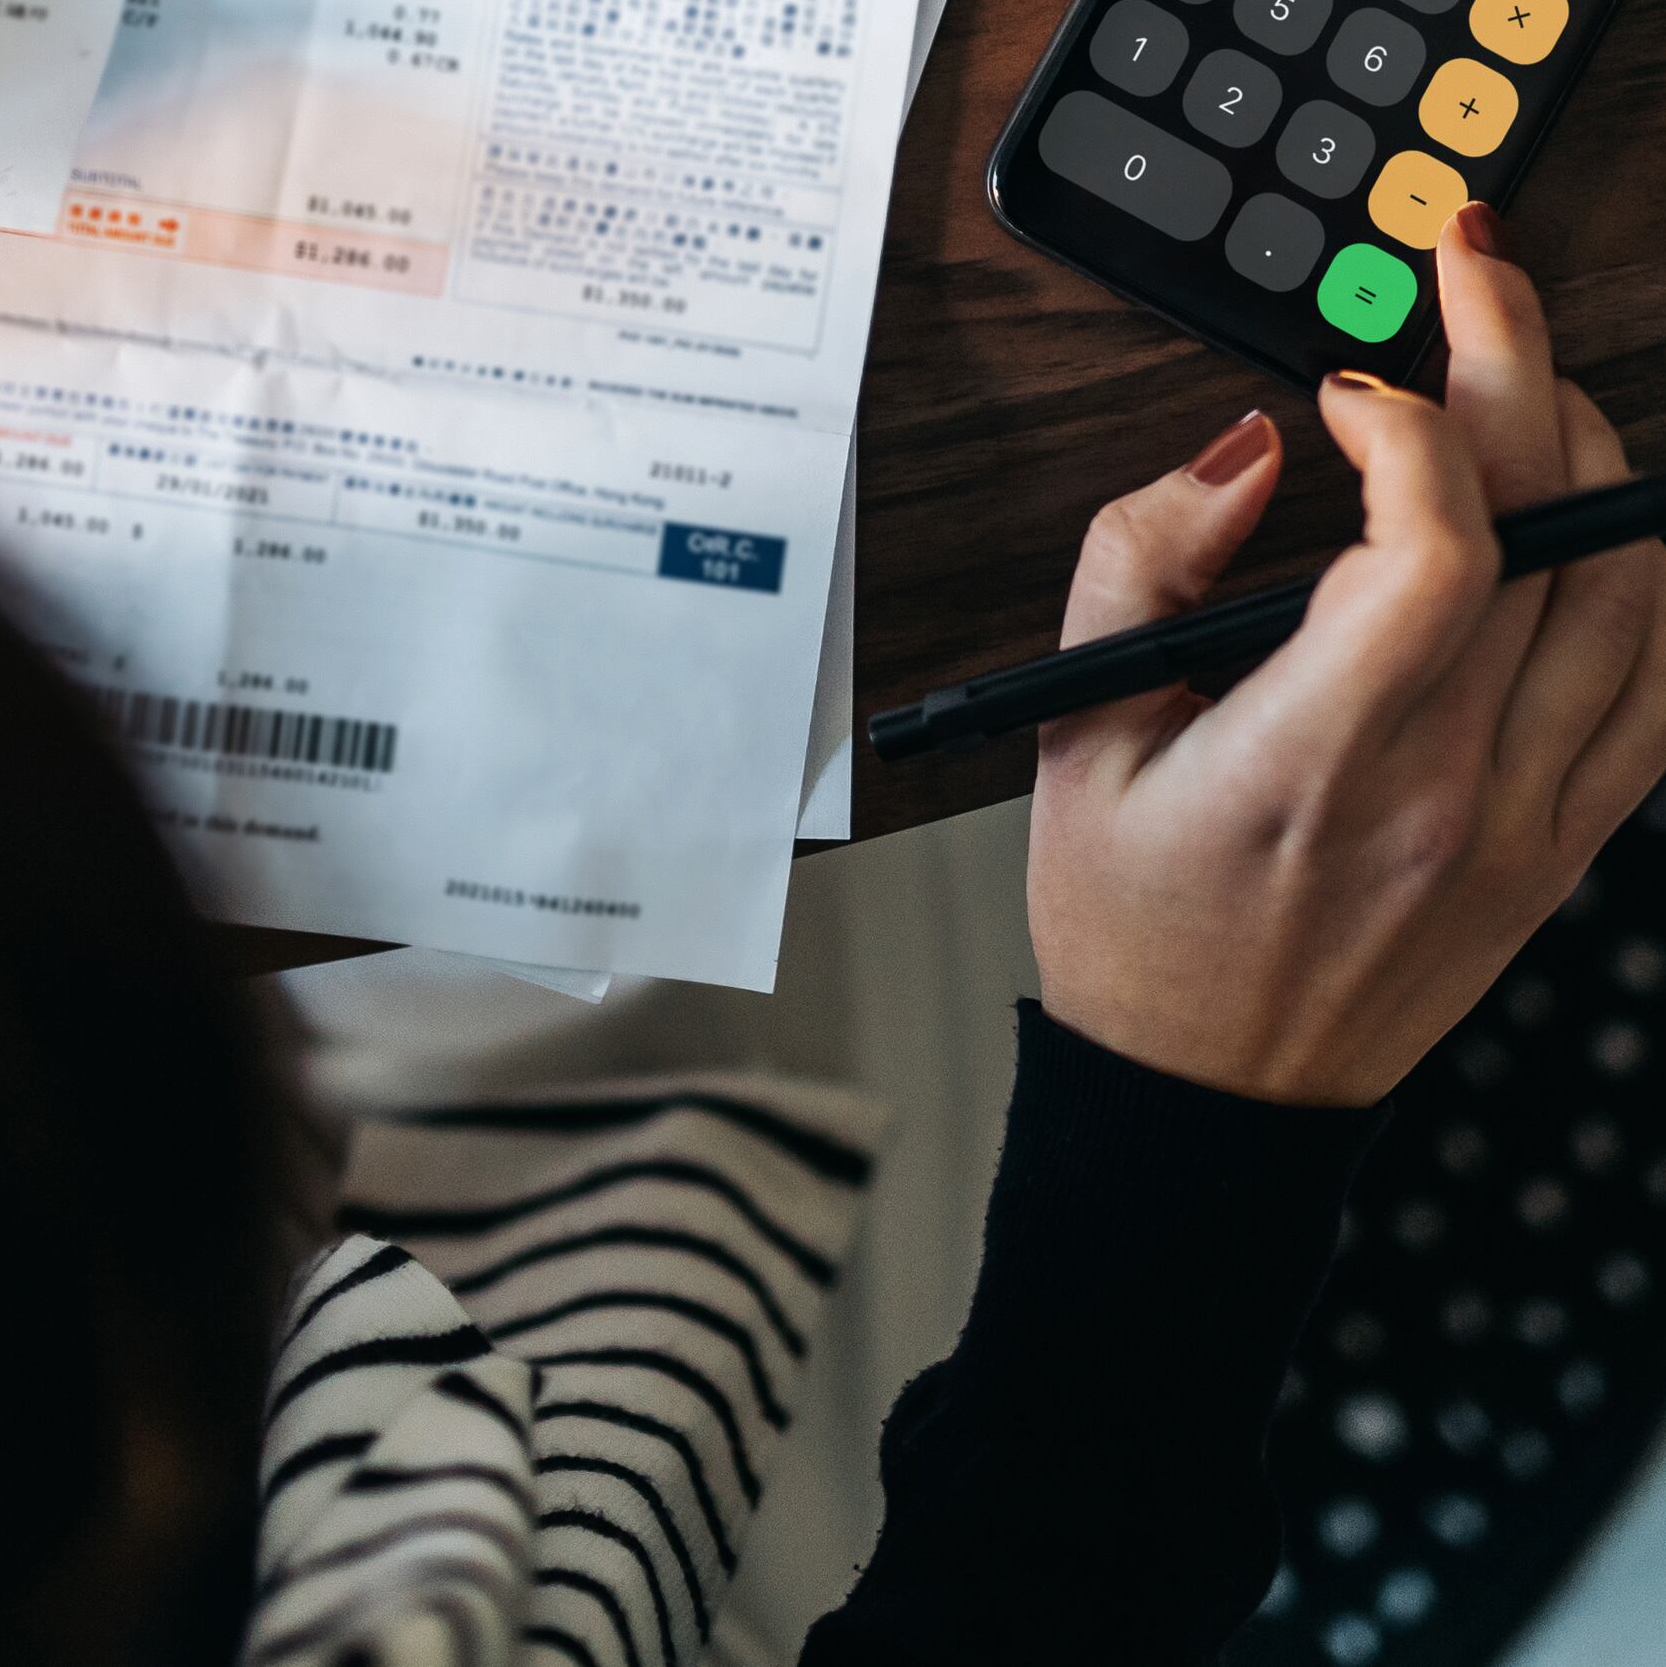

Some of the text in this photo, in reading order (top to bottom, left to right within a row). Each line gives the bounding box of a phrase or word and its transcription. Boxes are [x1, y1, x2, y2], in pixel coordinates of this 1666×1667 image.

[1132, 37, 1148, 62] 1
[1364, 45, 1388, 72] 6
[1218, 86, 1243, 115] 2
[1312, 137, 1336, 165] 3
[1124, 154, 1147, 181] 0
